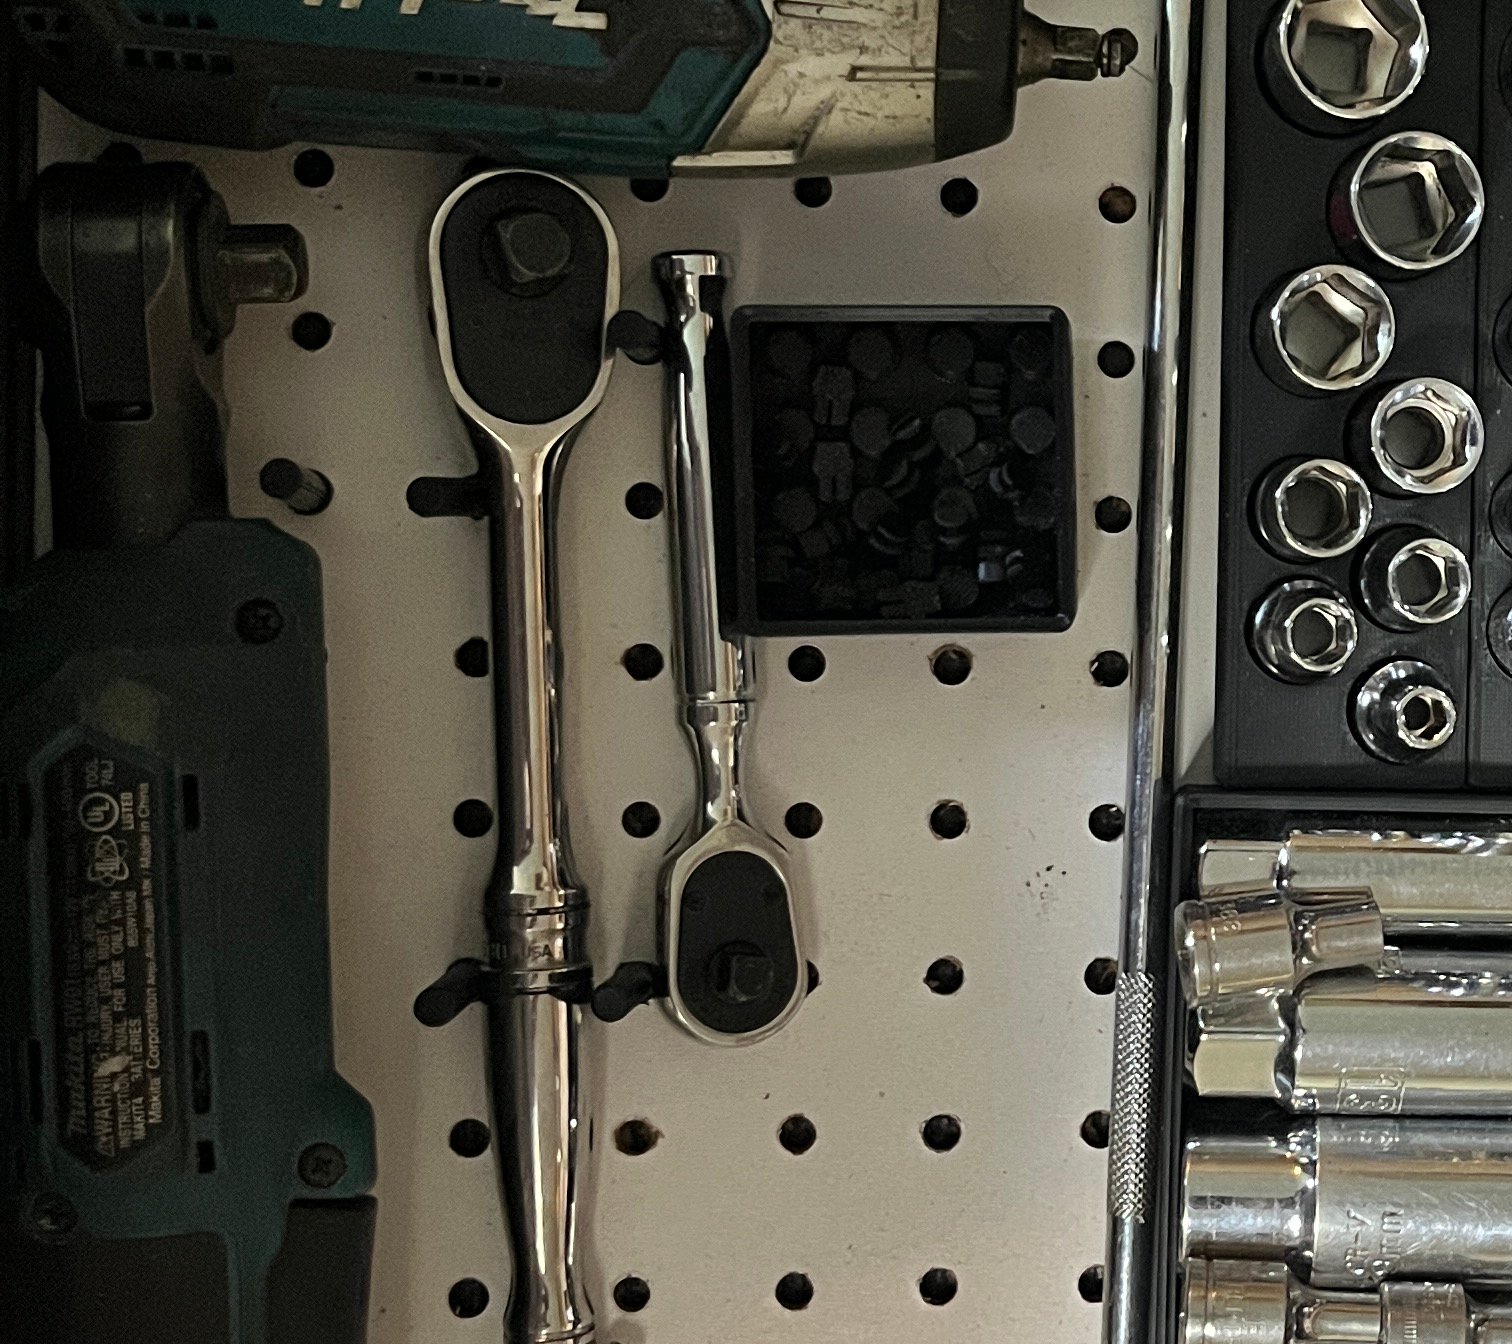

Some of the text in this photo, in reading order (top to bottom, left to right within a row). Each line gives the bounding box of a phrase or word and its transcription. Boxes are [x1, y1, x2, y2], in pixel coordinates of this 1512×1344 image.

[120, 791, 135, 831] LISTED
[136, 782, 151, 818] China
[111, 926, 124, 954] ONLY
[112, 959, 125, 982] USE
[113, 988, 126, 1011] FOR
[145, 987, 161, 1069] Corporation
[132, 1096, 146, 1140] MAKITA
[147, 1077, 163, 1123] Makita
